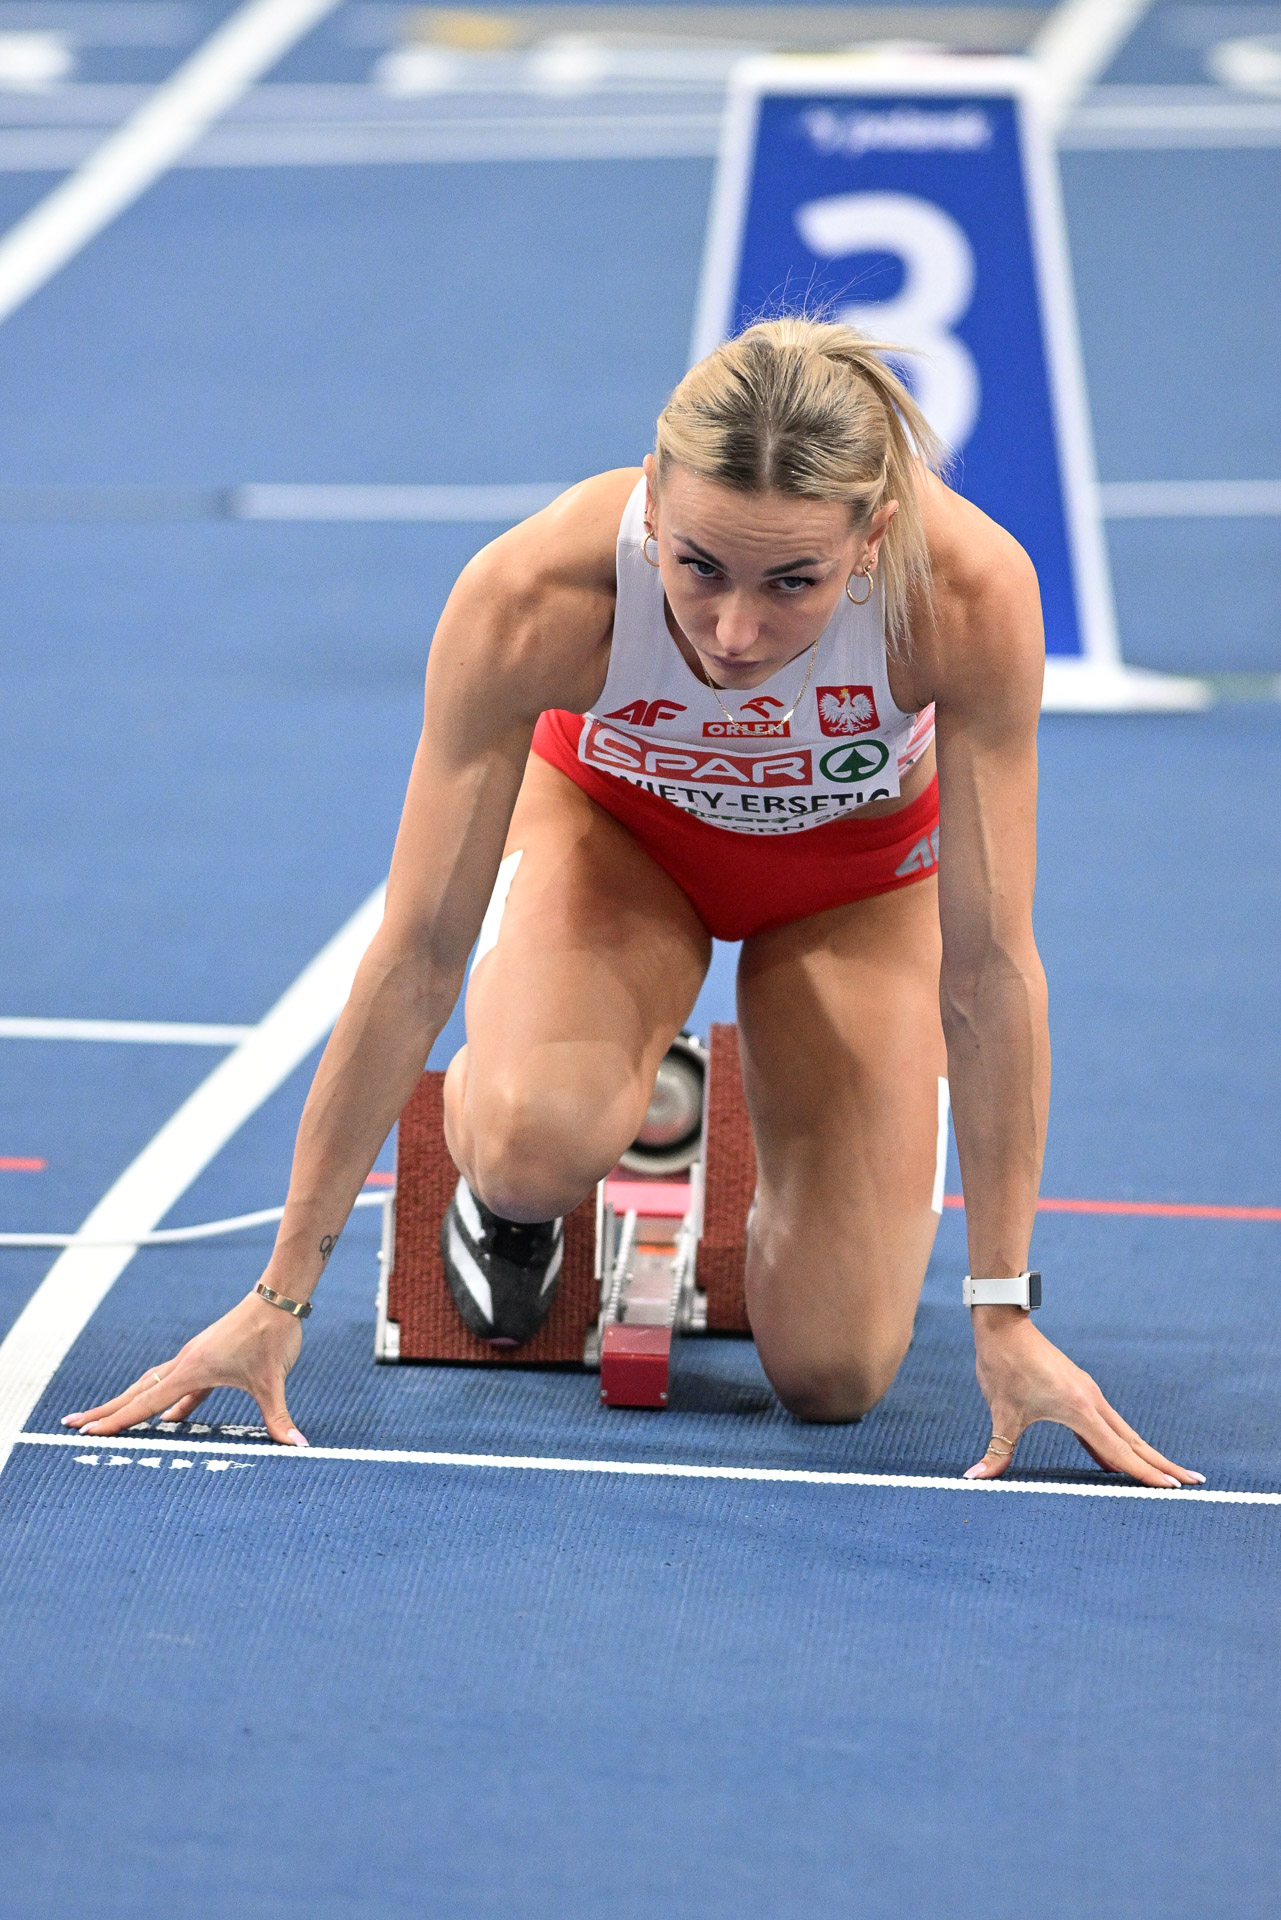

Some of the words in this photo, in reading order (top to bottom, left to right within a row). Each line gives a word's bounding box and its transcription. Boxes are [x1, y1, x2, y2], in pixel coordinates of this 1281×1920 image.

[797, 190, 982, 453] 3
[603, 699, 688, 727] 4F
[707, 723, 785, 736] ORLEN
[592, 728, 806, 784] SPAR
